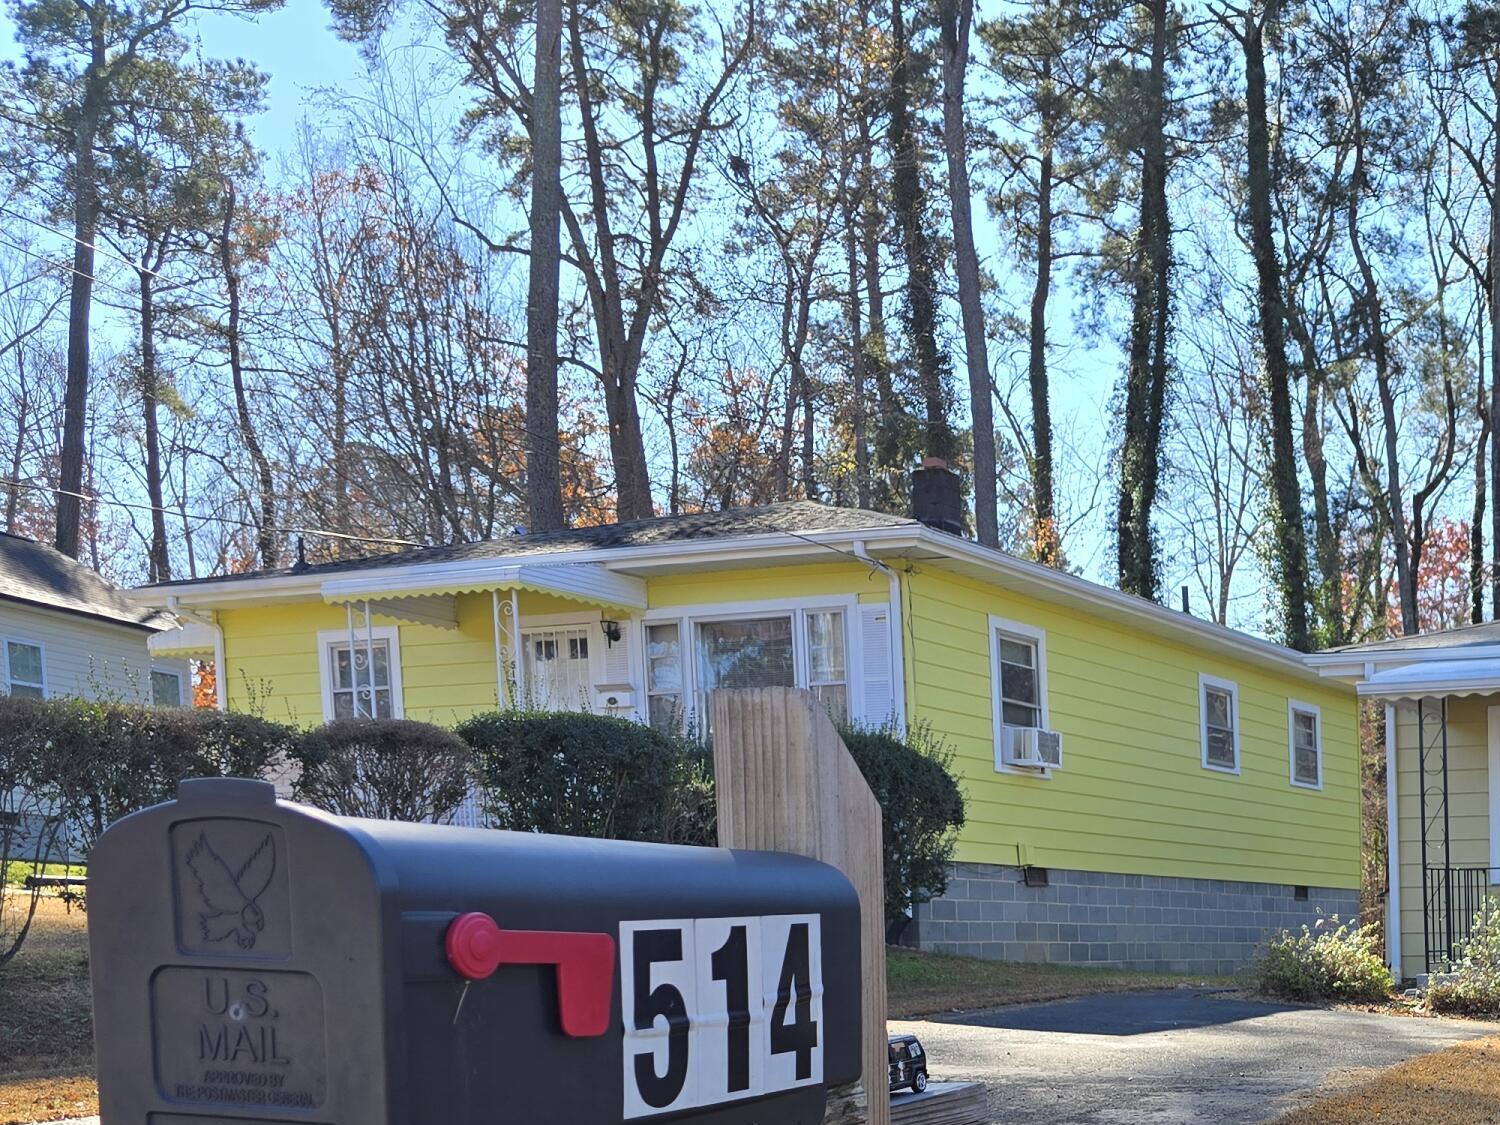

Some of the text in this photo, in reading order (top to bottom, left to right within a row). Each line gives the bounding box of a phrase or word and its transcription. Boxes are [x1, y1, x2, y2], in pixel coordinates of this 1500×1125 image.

[204, 977, 280, 1018] U.S.
[633, 923, 817, 1108] 514
[200, 1023, 290, 1065] MAIL
